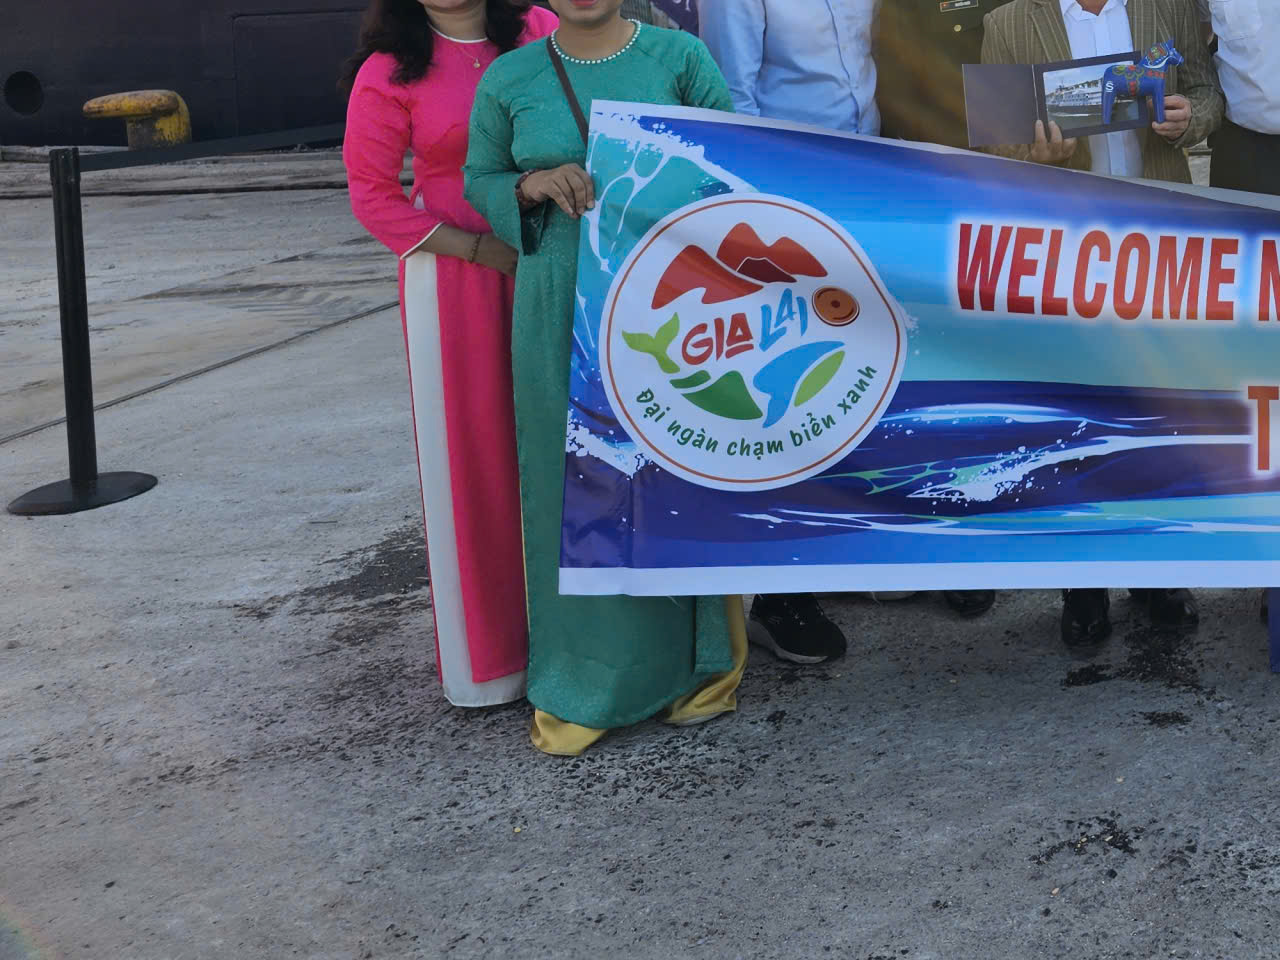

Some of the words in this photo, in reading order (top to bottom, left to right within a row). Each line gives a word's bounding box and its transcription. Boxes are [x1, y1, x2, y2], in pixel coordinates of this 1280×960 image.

[956, 223, 1239, 321] WELCOME
[681, 312, 754, 366] GIA
[759, 287, 808, 352] LAI
[636, 387, 670, 422] Đại
[667, 419, 718, 457] ngàn
[726, 436, 786, 461] chạm
[790, 411, 837, 448] biển
[837, 363, 878, 417] xanh
